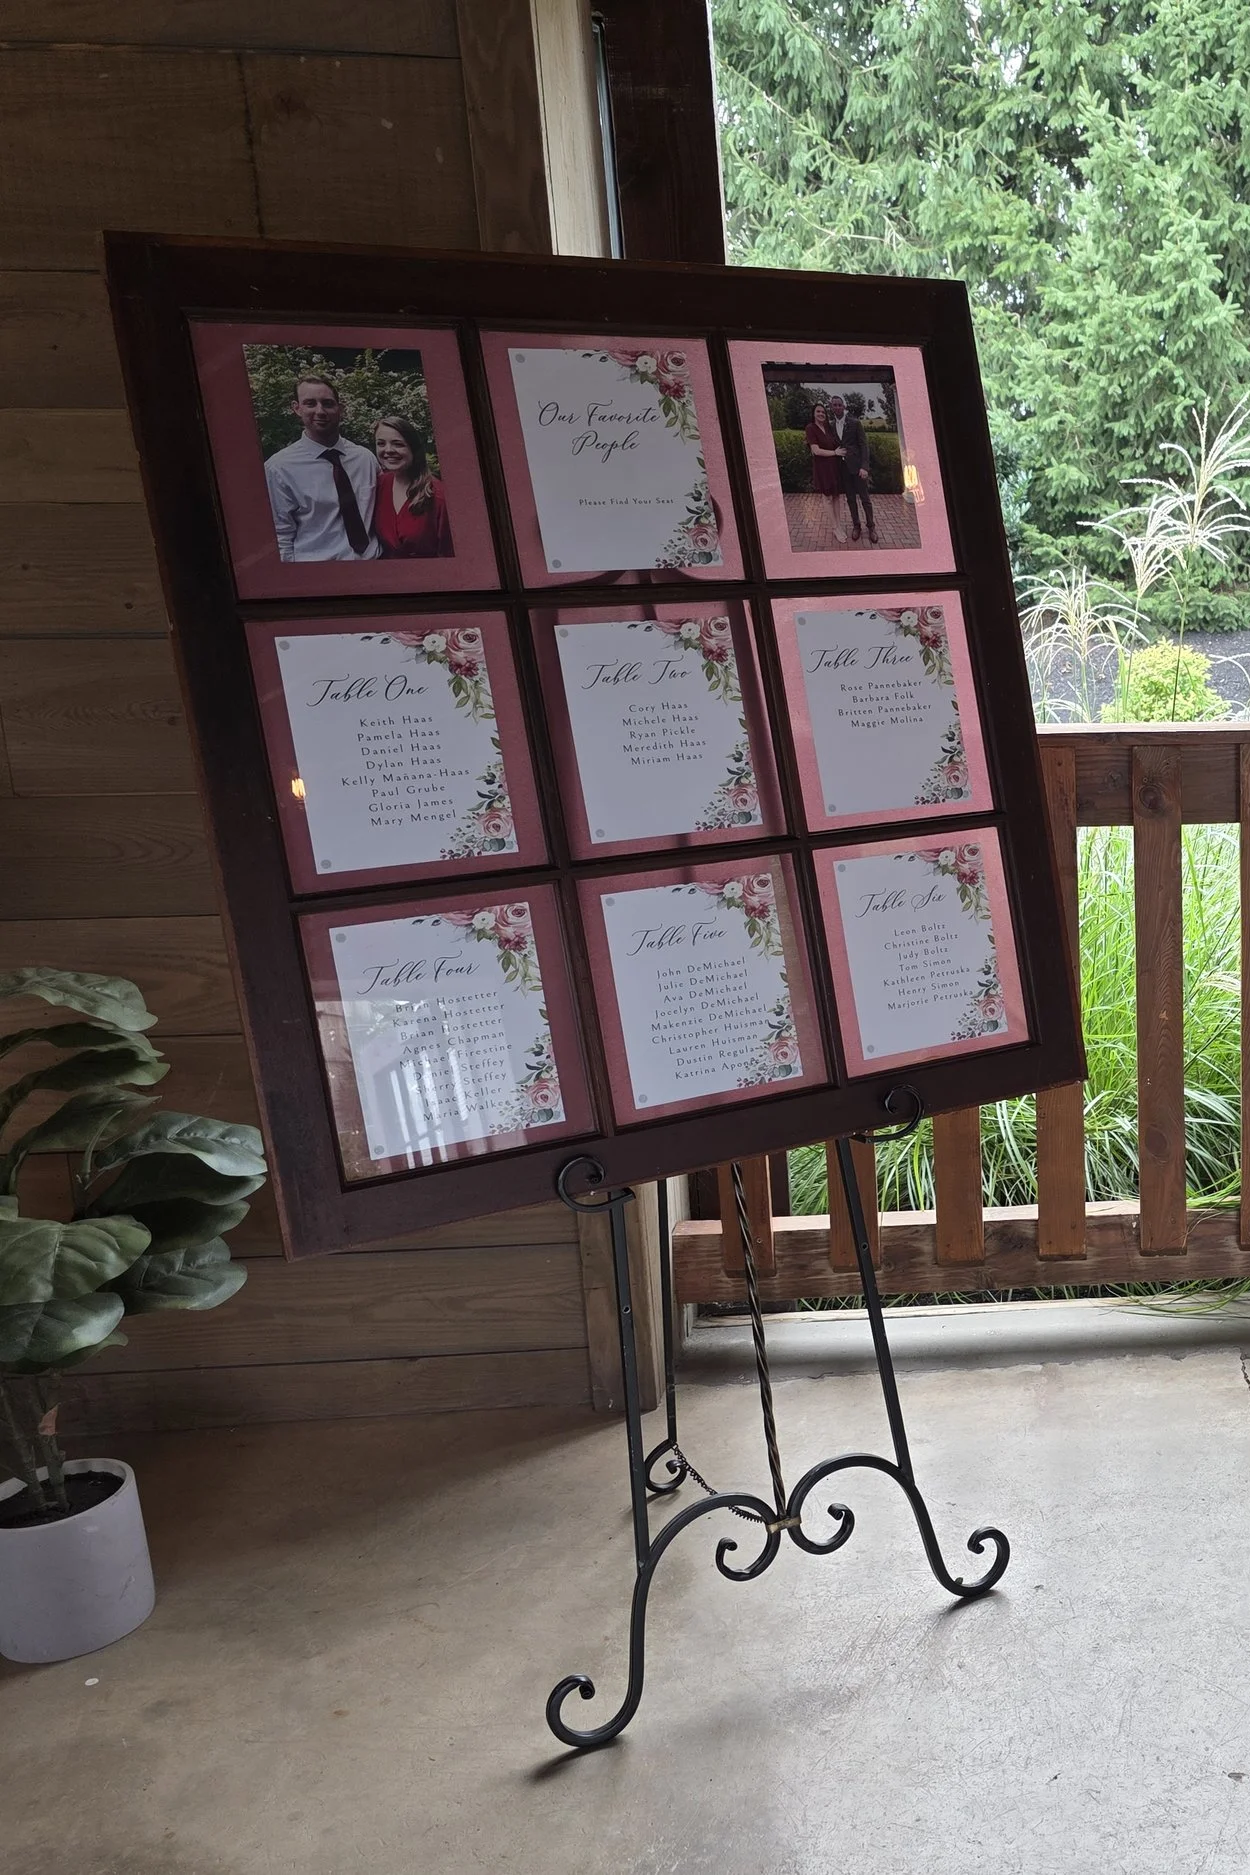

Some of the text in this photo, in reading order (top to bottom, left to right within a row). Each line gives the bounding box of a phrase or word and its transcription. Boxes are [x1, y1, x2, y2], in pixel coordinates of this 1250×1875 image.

[538, 399, 661, 427] Our Favorite
[571, 430, 641, 464] People
[579, 498, 606, 506] Please
[806, 641, 914, 674] Table Three
[581, 655, 692, 690] Table Two
[306, 673, 428, 707] Table One
[840, 679, 922, 692] Rose Pannebaker
[852, 692, 915, 704] Barbara Folk
[838, 703, 932, 717] Britten Pannebaker
[359, 715, 433, 728] Keith Haas
[622, 714, 699, 727] Michele Haas
[851, 716, 924, 729] Maggie Molina
[357, 729, 441, 742] Pamela Haas
[629, 727, 697, 740] Ryan Pickle
[361, 742, 442, 756] Daniel Haas
[623, 739, 707, 753] Meredith Haas
[631, 753, 704, 766] Miriam Haas
[340, 775, 376, 787] Kelly
[368, 798, 454, 813] Gloria James
[370, 809, 457, 827] Mary Mengel
[855, 885, 947, 918] Table Six
[626, 917, 728, 957] Table Five
[356, 950, 480, 995] Table Four
[657, 956, 746, 980] John DeMichael
[899, 958, 951, 972] Tom Simon
[883, 967, 971, 987] Kathleen Petruska
[663, 982, 748, 1004] Ava DeMichael
[898, 980, 960, 996] Henry Simon
[444, 1003, 505, 1019] Hostetter
[651, 1004, 768, 1032] Makenzie DeMichael
[402, 1031, 505, 1055] Agnes Chapman
[669, 1033, 758, 1055] Lauren Huisman
